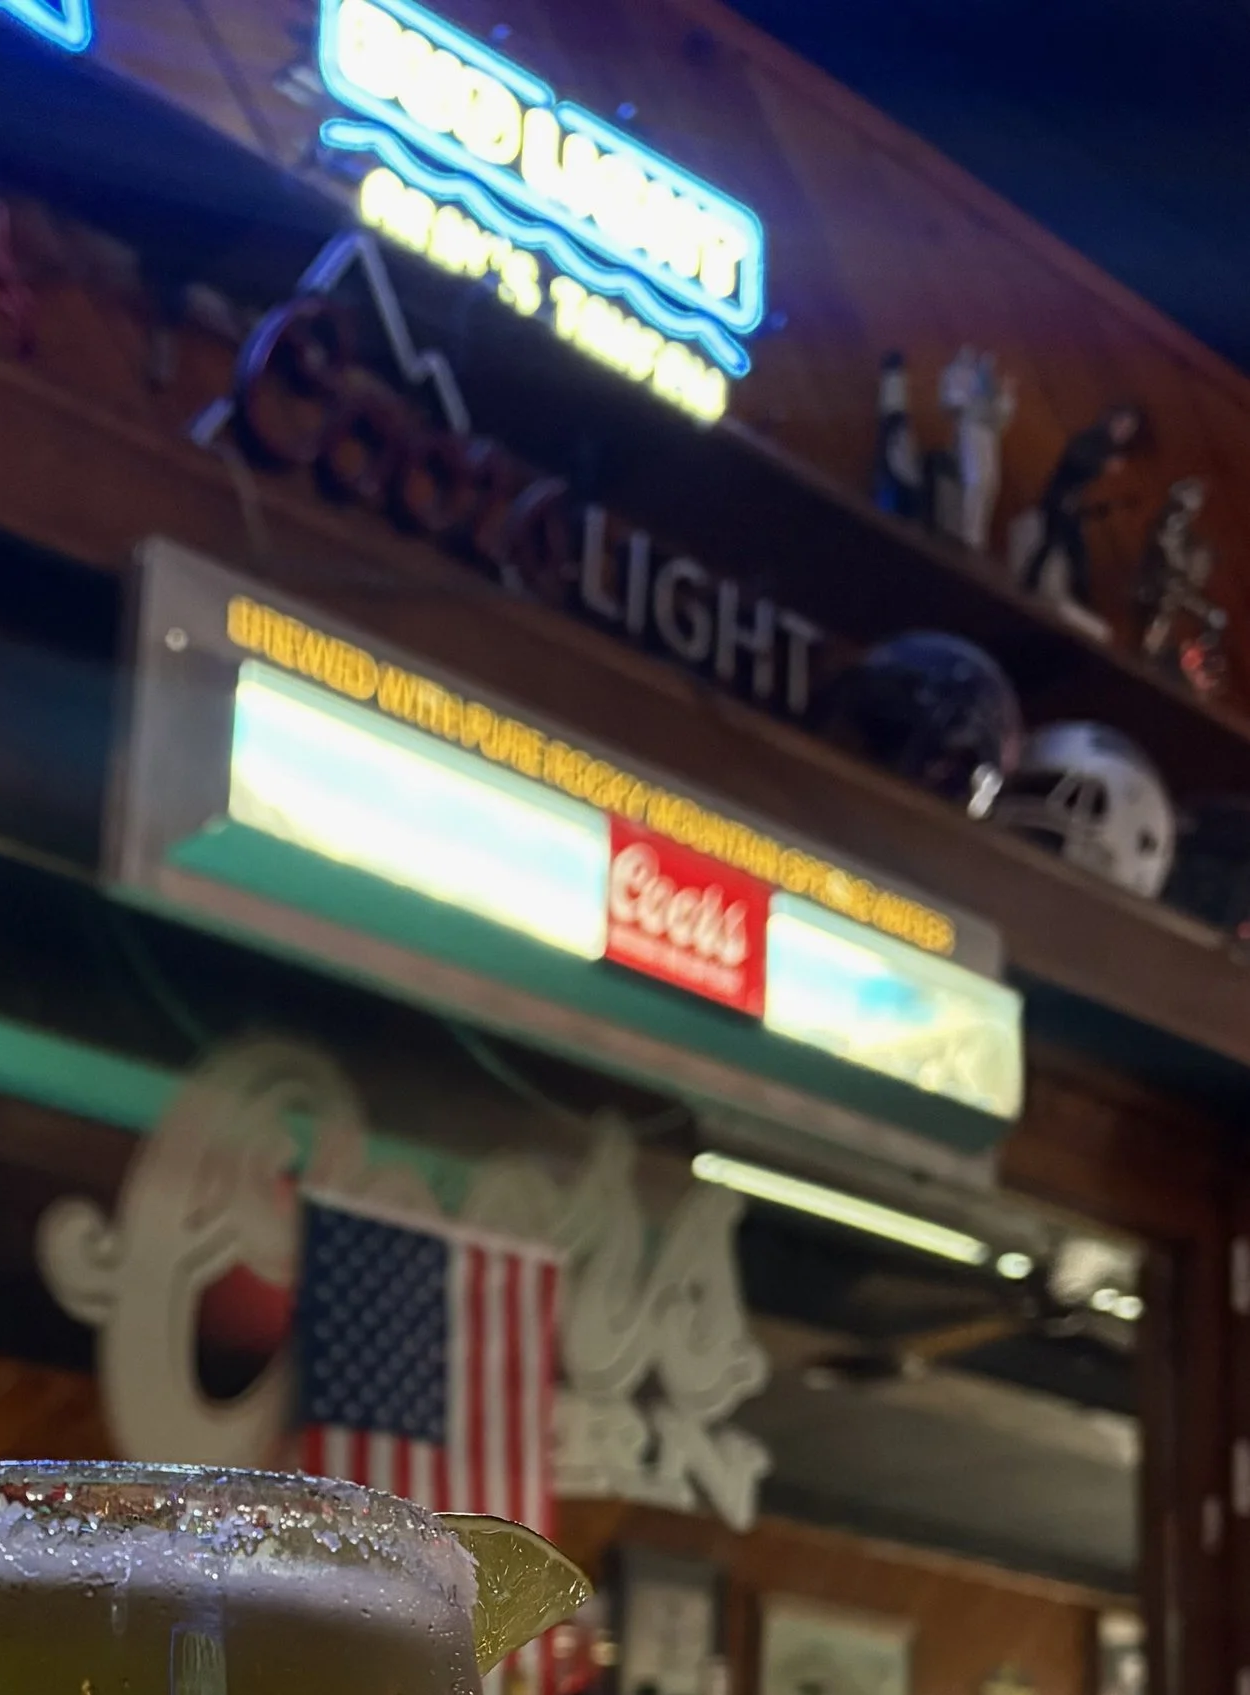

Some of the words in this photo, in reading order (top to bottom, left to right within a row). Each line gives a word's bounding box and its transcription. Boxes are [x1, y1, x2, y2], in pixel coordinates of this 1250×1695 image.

[338, 0, 523, 166] BUD
[521, 106, 750, 300] LIGHT
[581, 504, 823, 716] LIGHT
